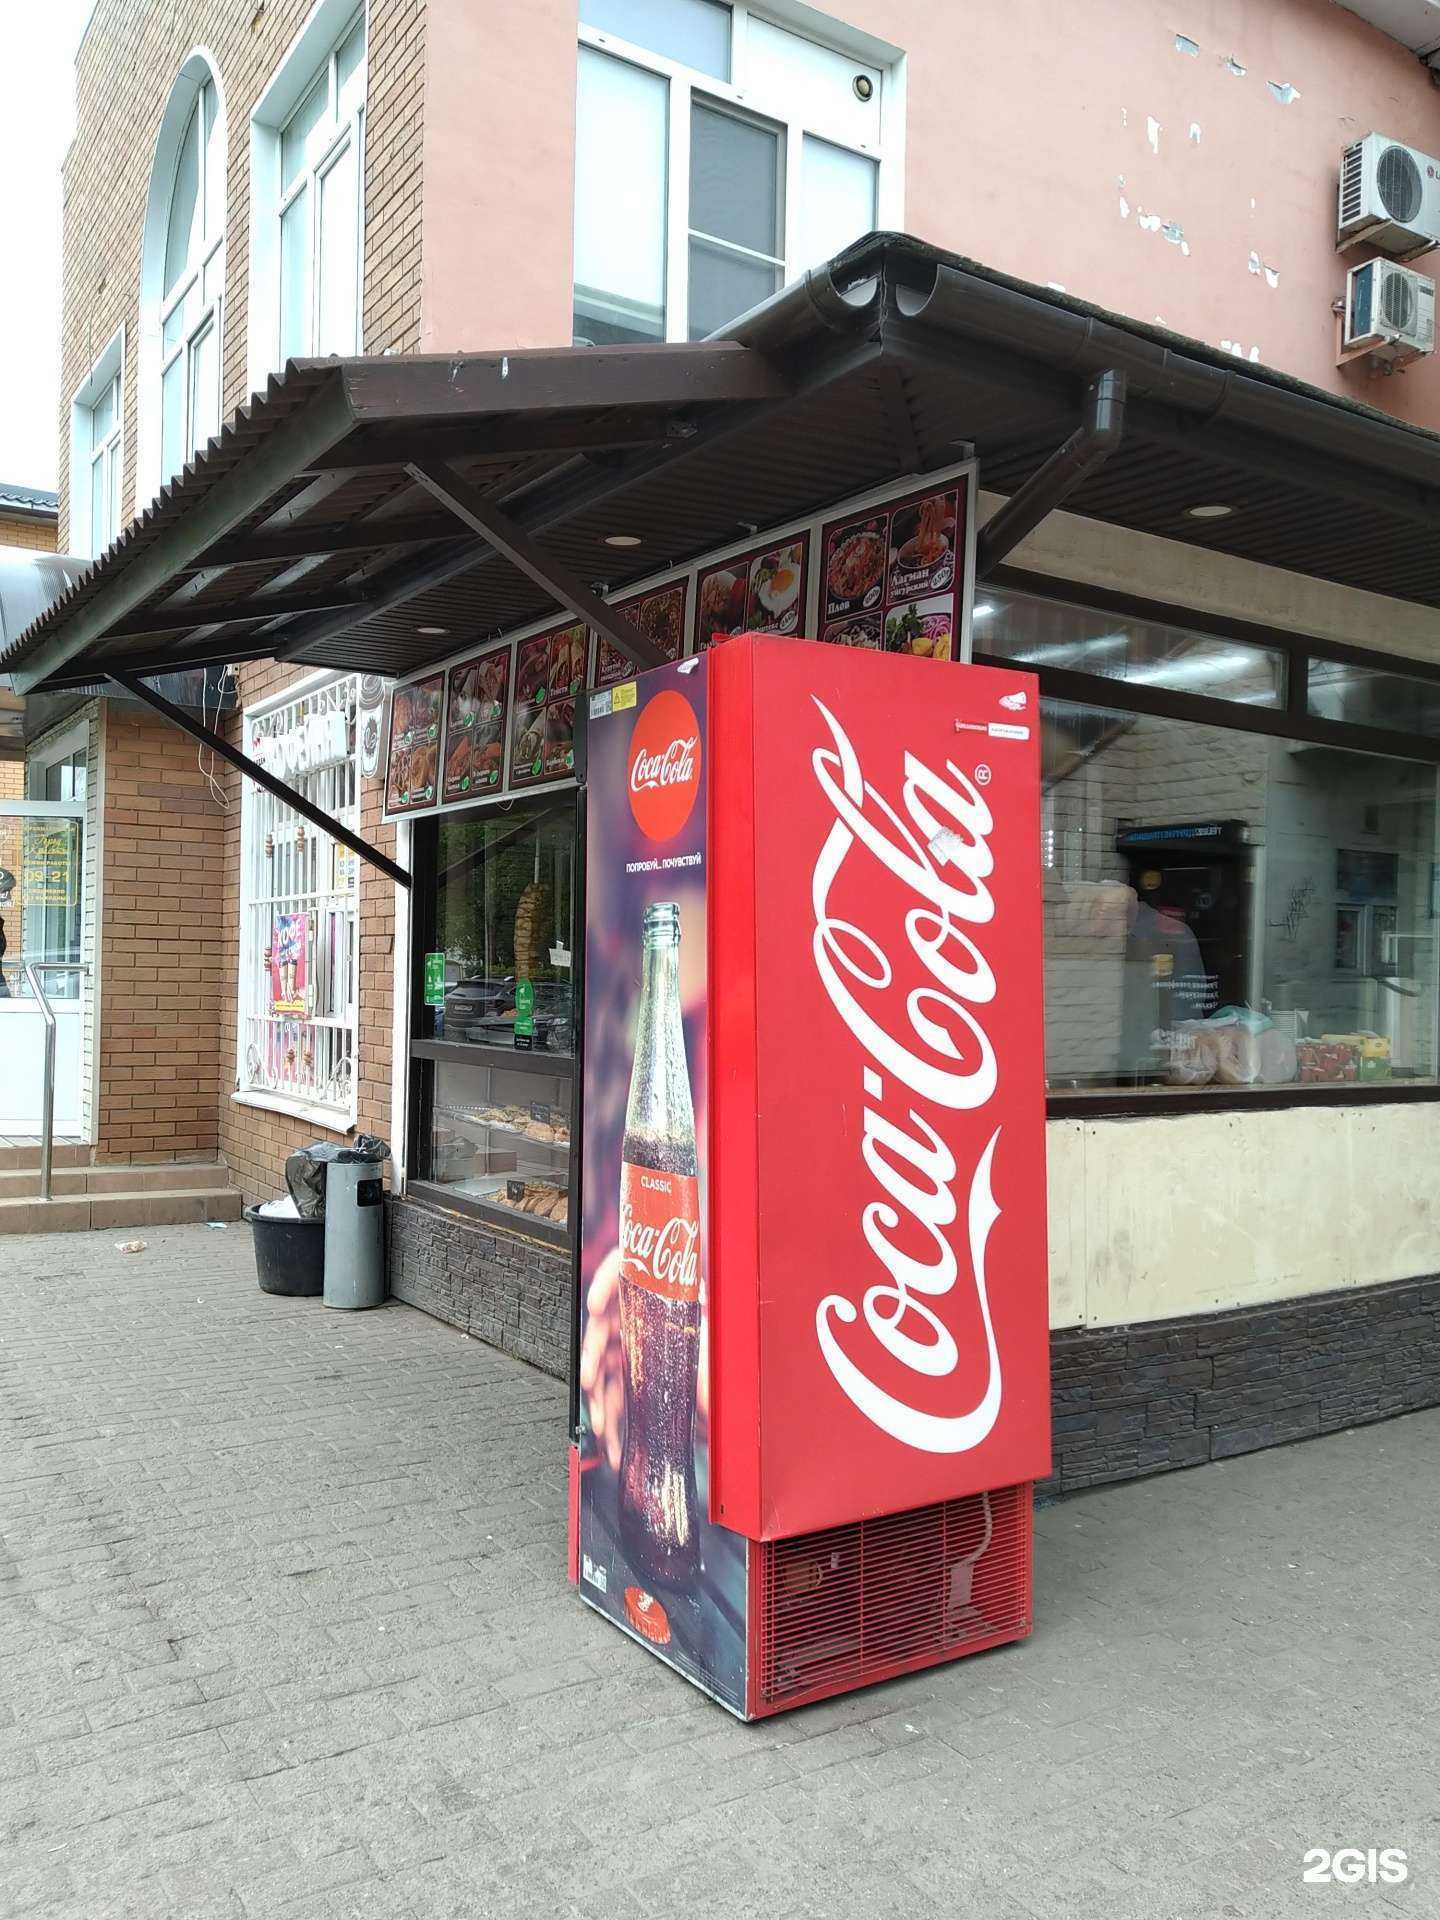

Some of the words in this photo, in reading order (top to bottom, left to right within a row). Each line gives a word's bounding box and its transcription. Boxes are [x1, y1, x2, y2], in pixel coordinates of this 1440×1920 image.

[891, 568, 930, 586] Лагман
[828, 600, 850, 614] Плов
[631, 737, 697, 792] Coca-Cola
[812, 695, 1003, 1454] Coca-Cola
[641, 1176, 672, 1193] CLASSIC
